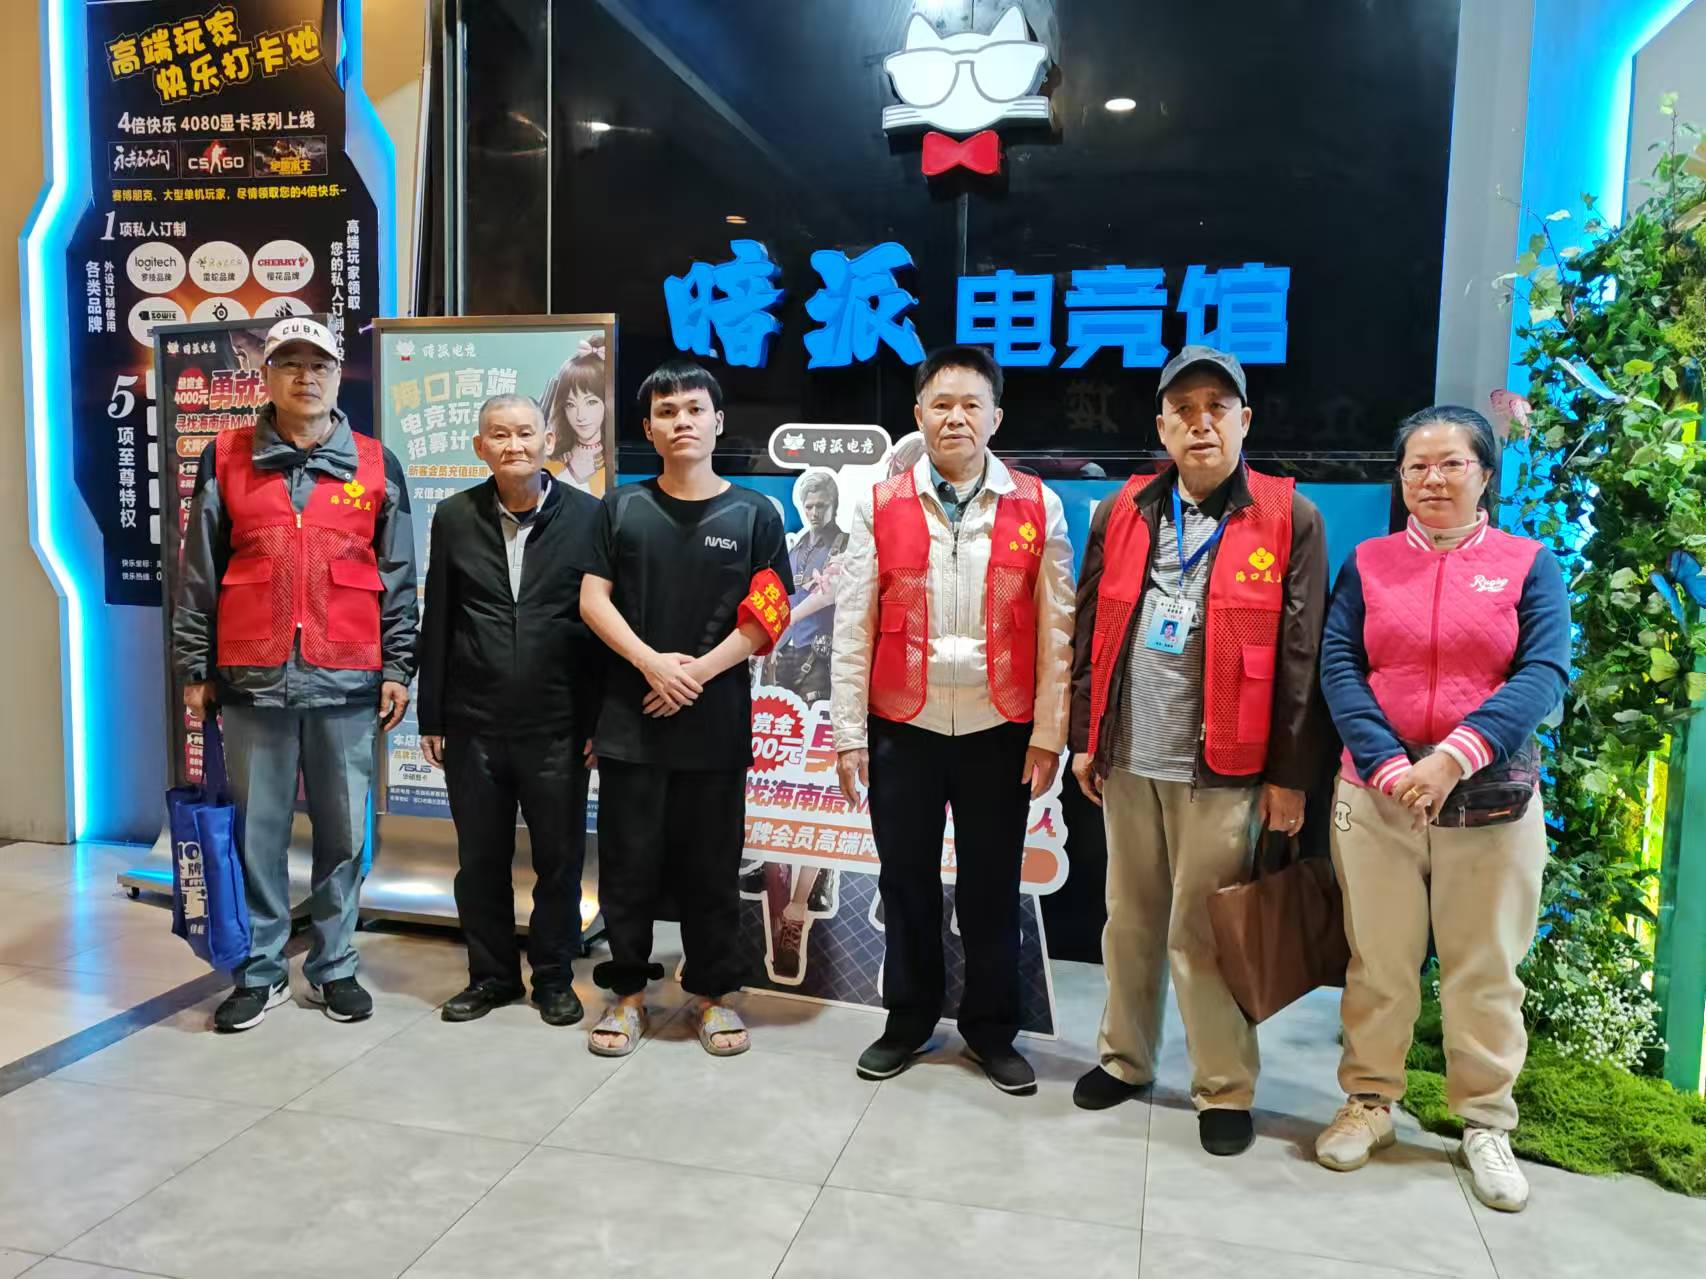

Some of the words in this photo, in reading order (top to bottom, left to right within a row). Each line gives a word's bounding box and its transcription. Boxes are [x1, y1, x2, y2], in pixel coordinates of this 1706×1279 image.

[109, 9, 238, 76] 高端玩家
[156, 25, 320, 101] 快乐打卡地
[117, 111, 177, 134] 4倍快乐
[180, 110, 316, 132] 4080显卡系列上线
[134, 255, 177, 271] logitech
[257, 257, 297, 267] CHERRY
[346, 219, 360, 311] 高端玩家领取
[85, 260, 103, 333] 各类品牌
[104, 260, 116, 333] 外设订制使用
[282, 323, 321, 338] CUBA
[704, 535, 738, 552] NASA
[752, 712, 795, 736] 赏金
[399, 763, 432, 774] ASUS
